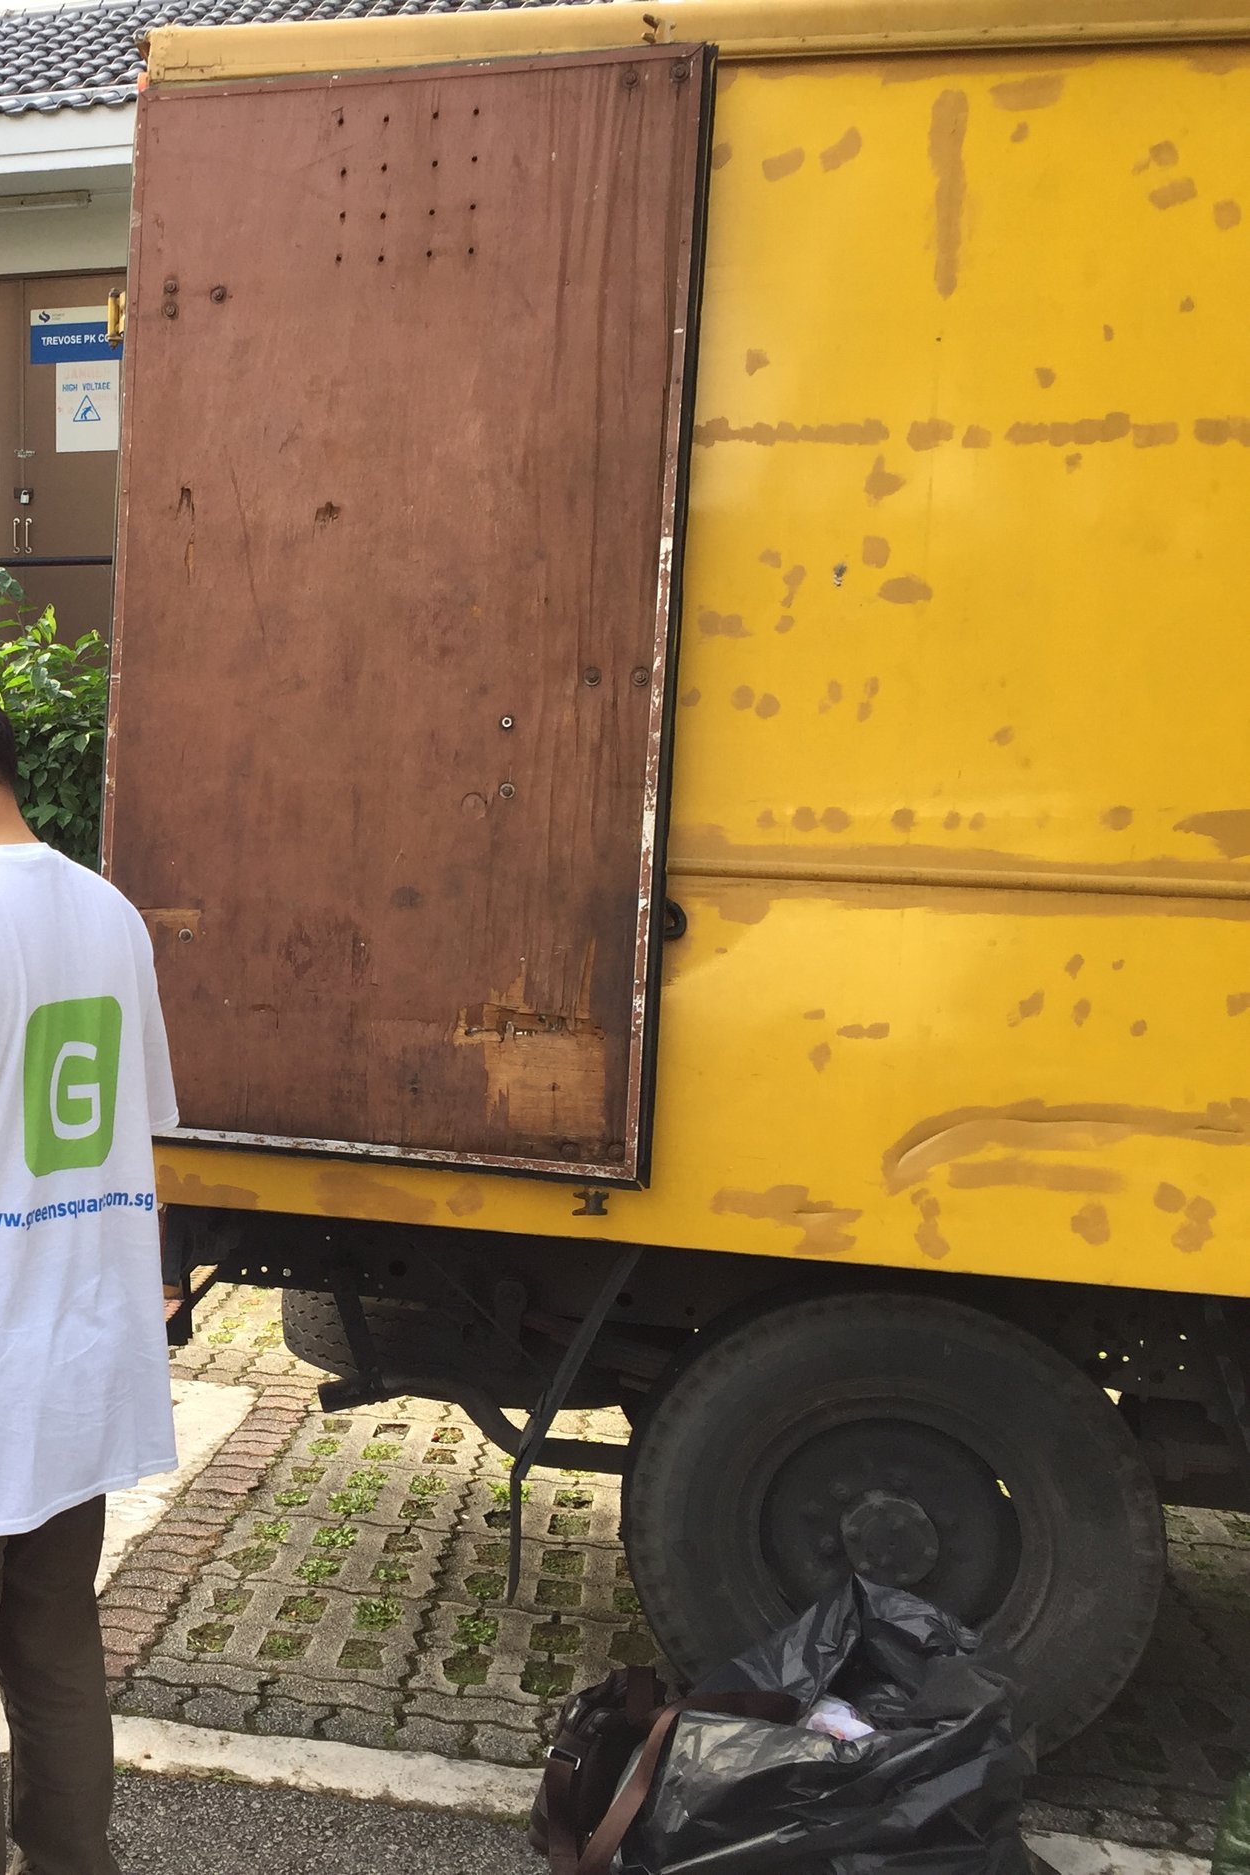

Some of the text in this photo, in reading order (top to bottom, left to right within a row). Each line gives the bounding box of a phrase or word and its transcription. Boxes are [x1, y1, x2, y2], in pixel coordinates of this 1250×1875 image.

[41, 335, 82, 346] TREVOSE
[84, 334, 96, 343] PK
[62, 382, 111, 392] HIGH VOLTAGE
[49, 1040, 101, 1141] G
